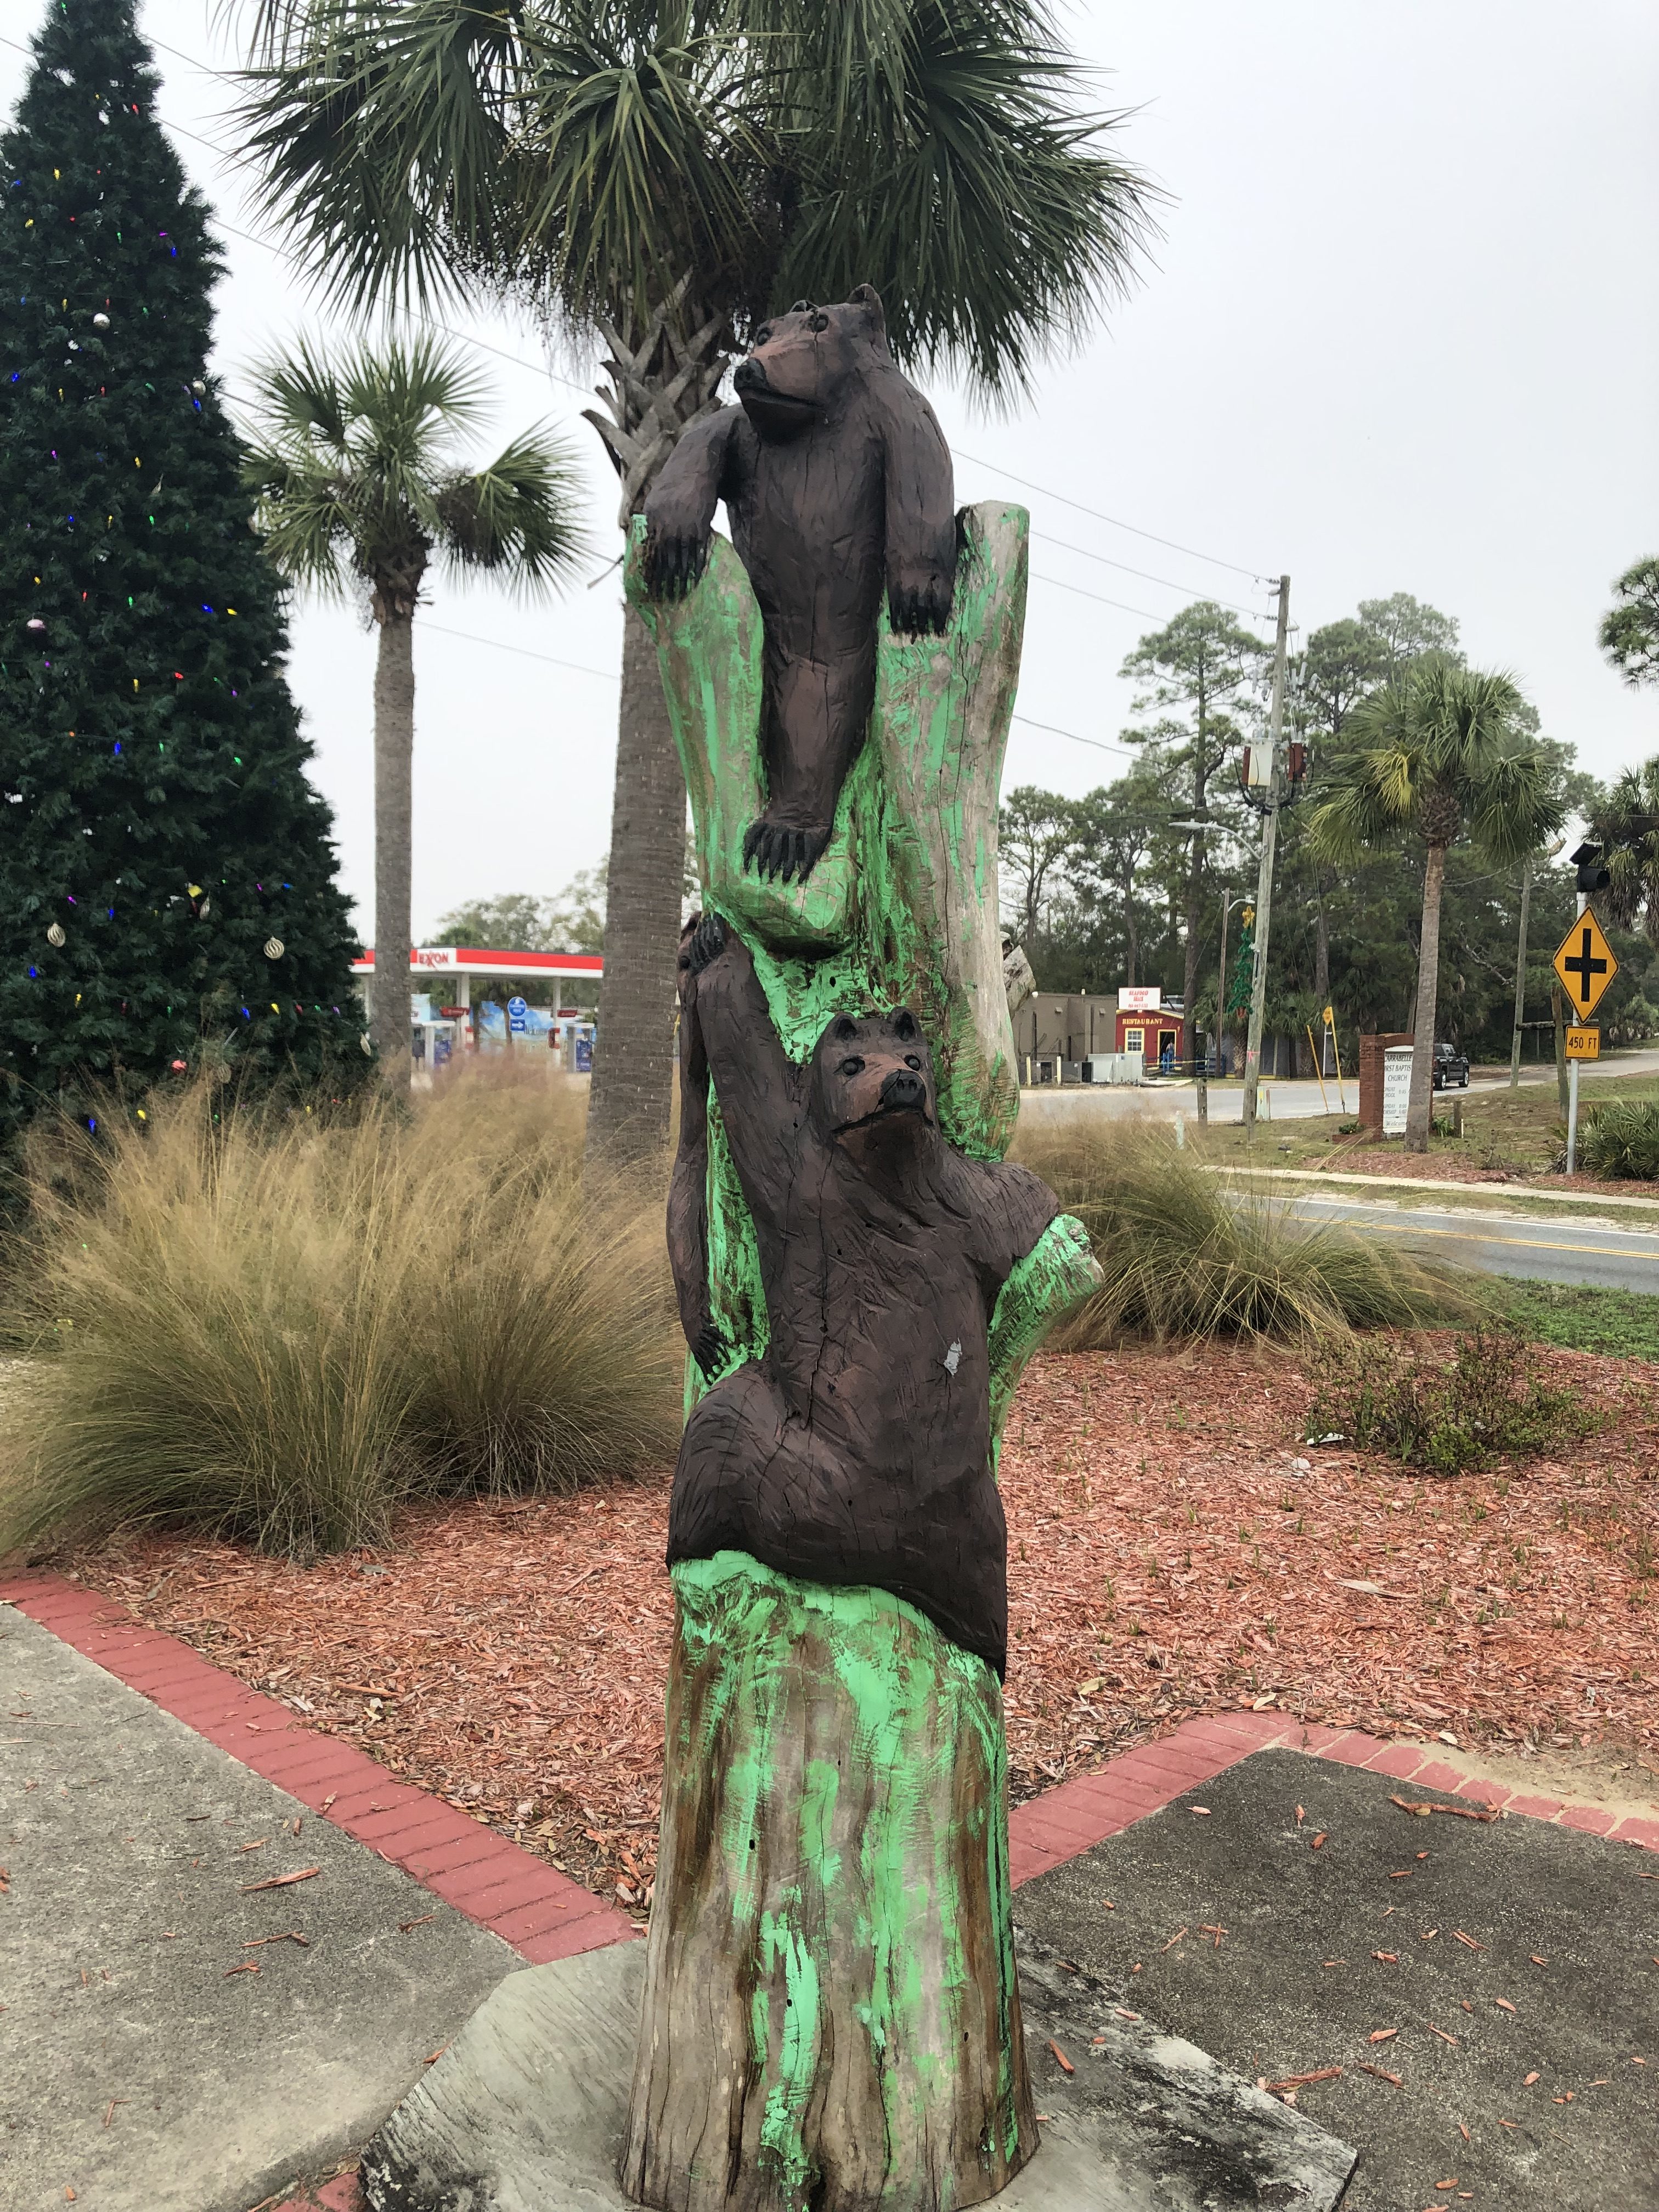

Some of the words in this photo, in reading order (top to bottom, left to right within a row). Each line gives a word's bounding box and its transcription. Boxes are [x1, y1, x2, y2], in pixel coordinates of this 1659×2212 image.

[419, 952, 448, 969] EXXON
[1568, 1036, 1584, 1049] 450
[1588, 1037, 1597, 1049] FT
